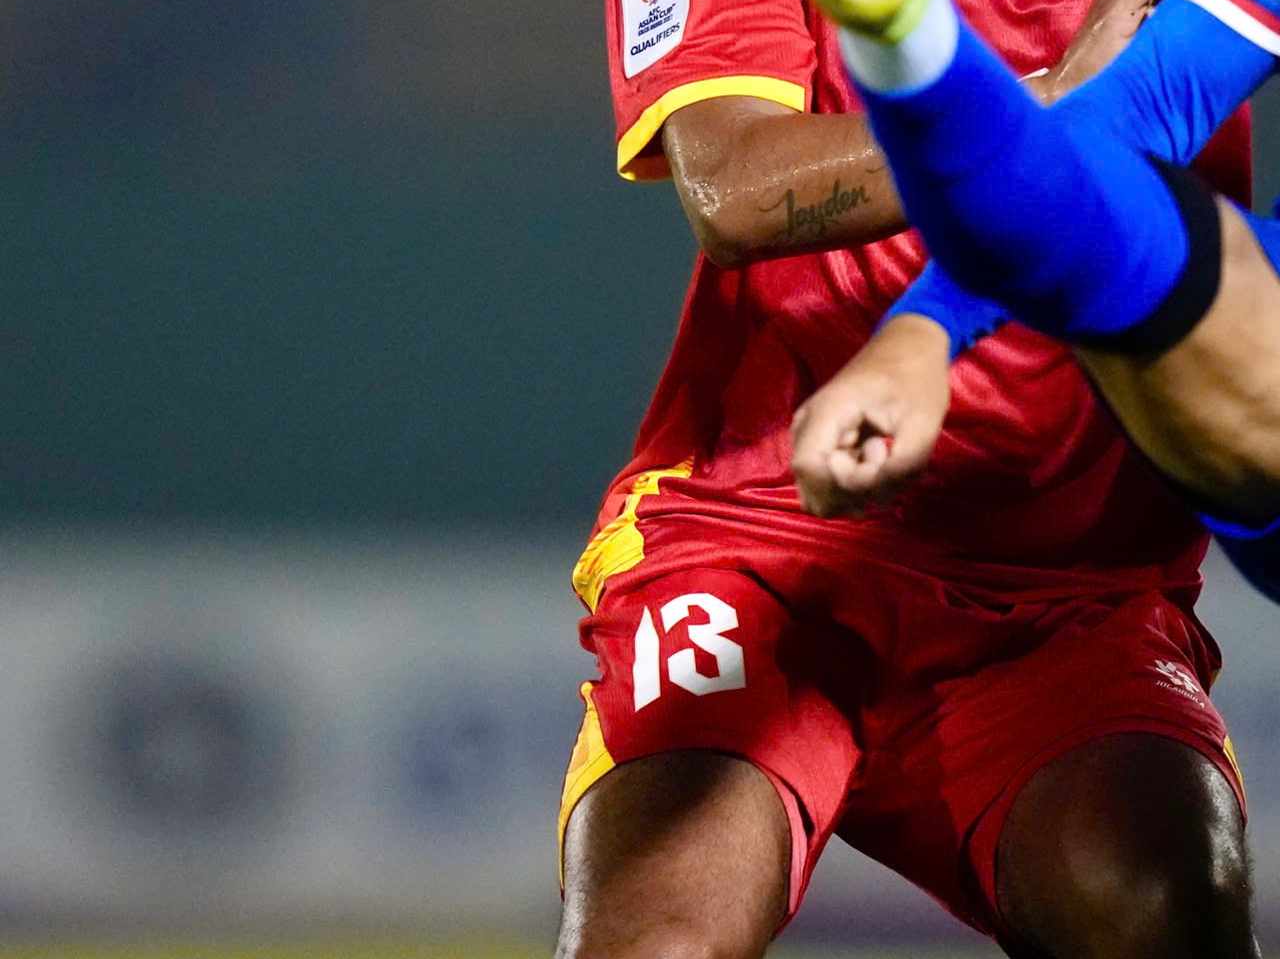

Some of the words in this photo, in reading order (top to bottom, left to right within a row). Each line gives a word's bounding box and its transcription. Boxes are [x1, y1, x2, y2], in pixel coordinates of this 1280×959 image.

[638, 14, 659, 29] ASIAN
[649, 6, 660, 16] AFC
[630, 21, 681, 56] QUALIFIERS
[632, 592, 747, 713] 13
